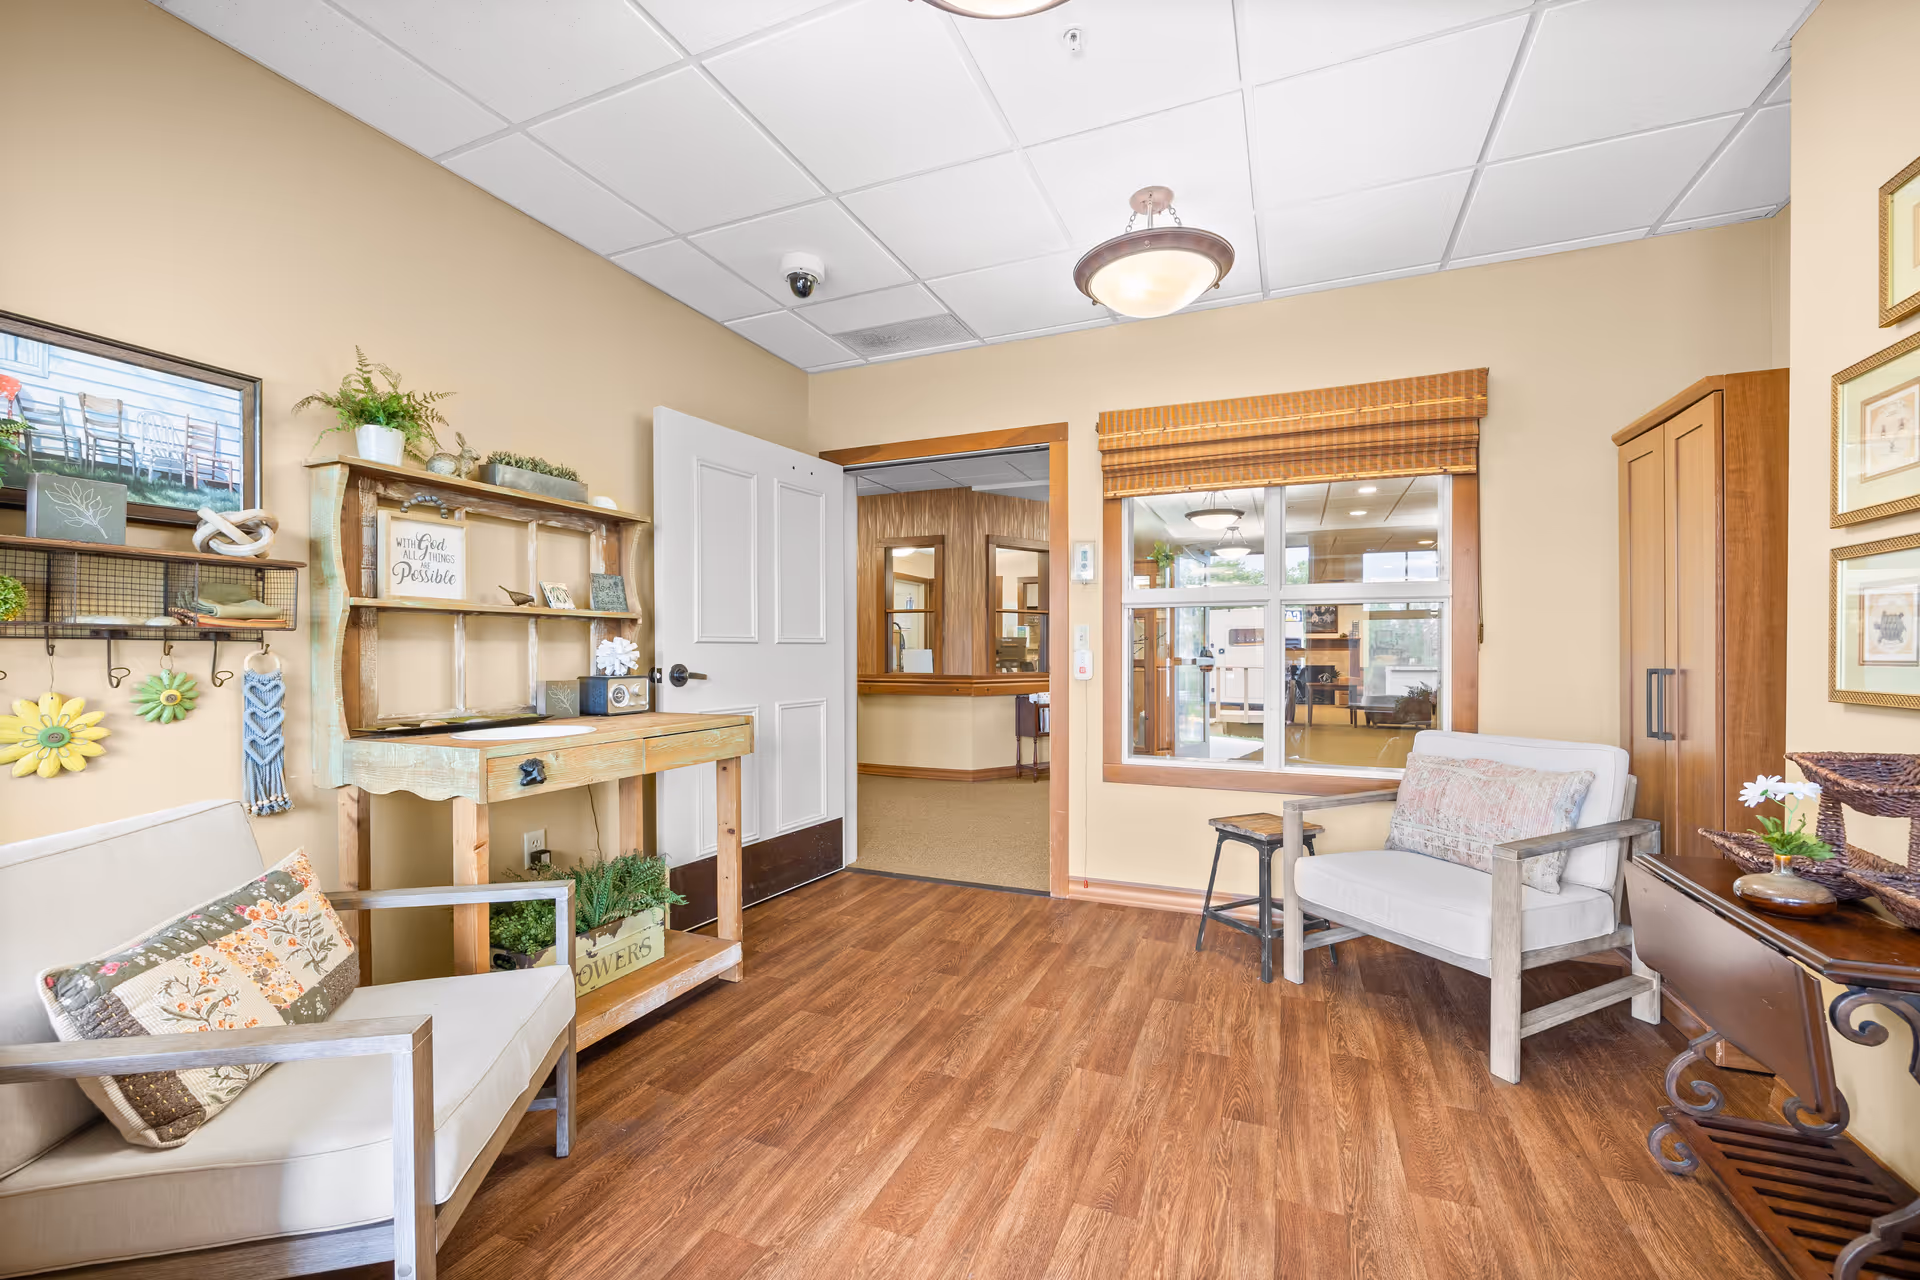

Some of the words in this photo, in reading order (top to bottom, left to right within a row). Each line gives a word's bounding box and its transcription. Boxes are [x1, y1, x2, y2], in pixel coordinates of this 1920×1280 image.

[396, 537, 416, 549] WITH
[416, 532, 447, 561] God
[402, 549, 418, 561] ALL
[429, 552, 455, 564] THINGS
[420, 562, 431, 570] ARE
[392, 561, 457, 585] Possible
